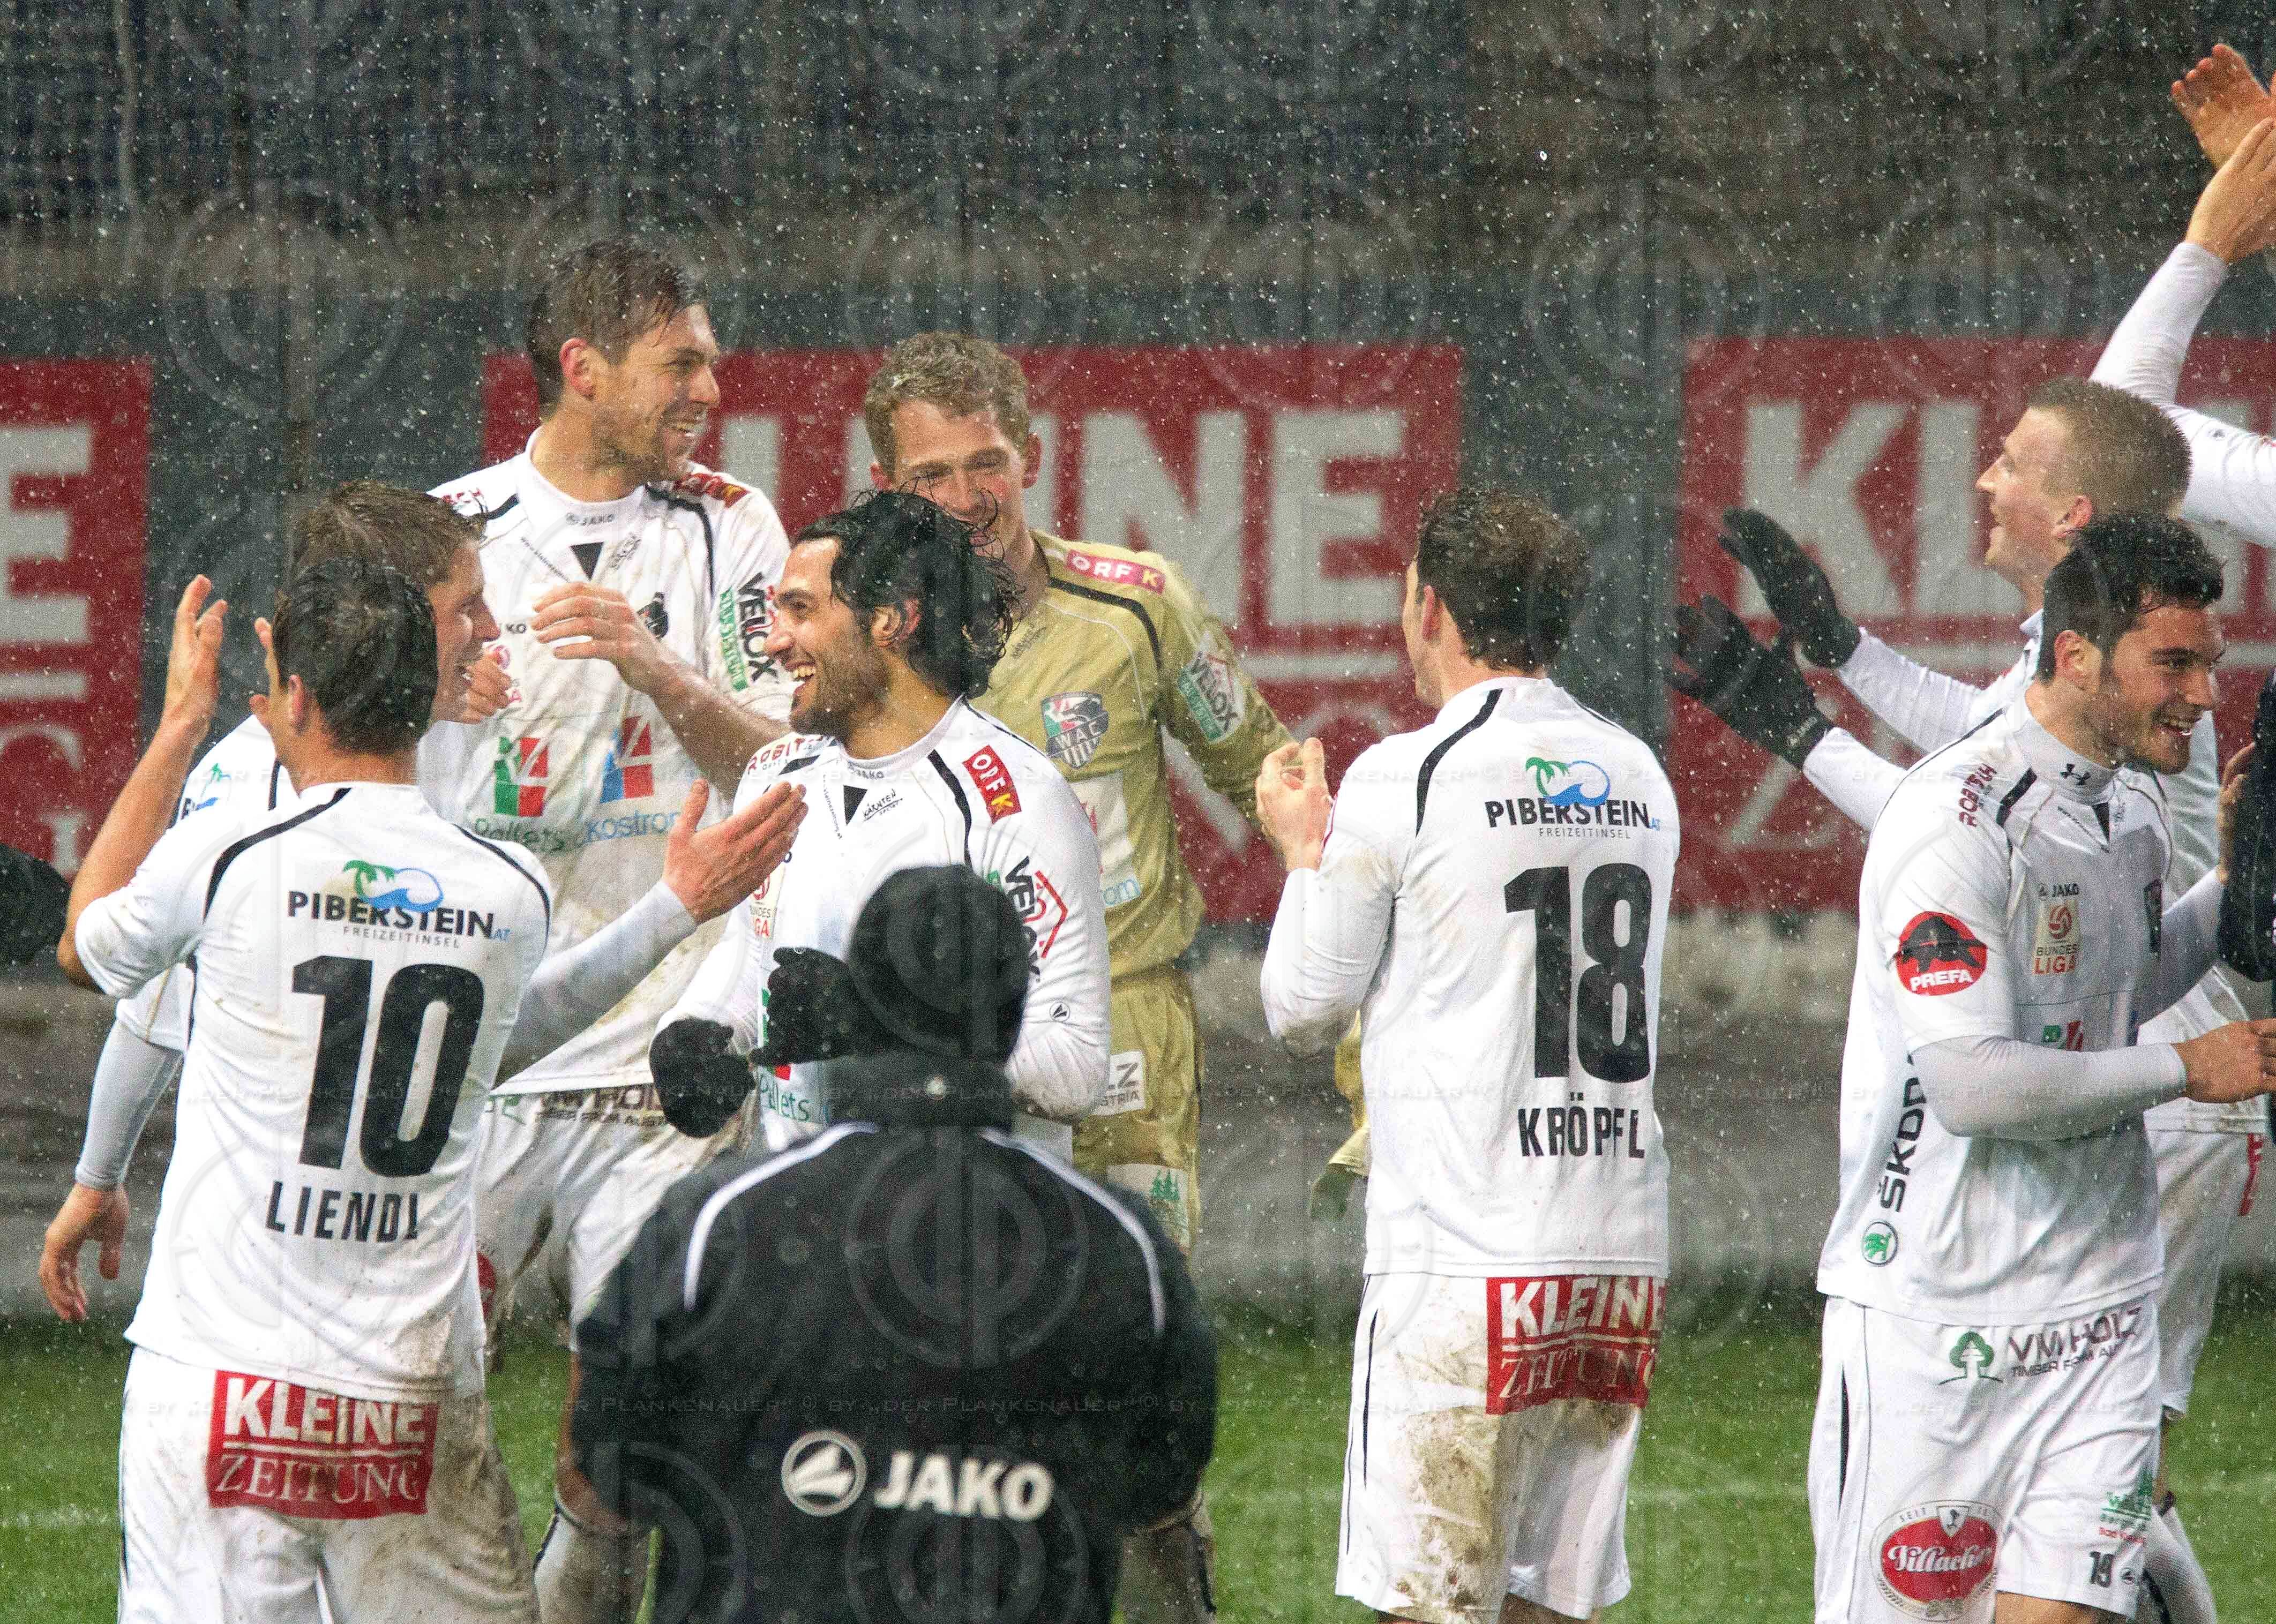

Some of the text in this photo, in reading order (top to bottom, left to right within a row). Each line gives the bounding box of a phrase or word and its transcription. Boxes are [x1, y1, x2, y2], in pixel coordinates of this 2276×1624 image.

[1072, 555, 1158, 587] ORF K
[738, 571, 778, 684] VELOX
[1055, 720, 1102, 749] WAC
[972, 754, 1014, 815] ORF K
[1485, 799, 1651, 830] PIBERSTEIN
[1539, 826, 1631, 839] FREIZEITINSEL
[2052, 883, 2080, 898] JAKO
[287, 890, 496, 941] PIBERSTEIN
[342, 926, 460, 949] FREIZEITINSEL
[2037, 943, 2078, 956] BUNDES
[1503, 862, 1653, 1084] 18
[1909, 968, 1973, 992] PREFA
[2034, 954, 2077, 974] LIGA
[292, 955, 485, 1178] 10
[1100, 1090, 1140, 1107] STRIA
[1518, 1091, 1645, 1159] KRÖPFL
[1877, 1051, 1927, 1213] ŠKOD
[223, 1378, 429, 1445] KLEINE
[215, 1454, 420, 1506] ZEITUNG
[873, 1450, 1055, 1523] JAKO
